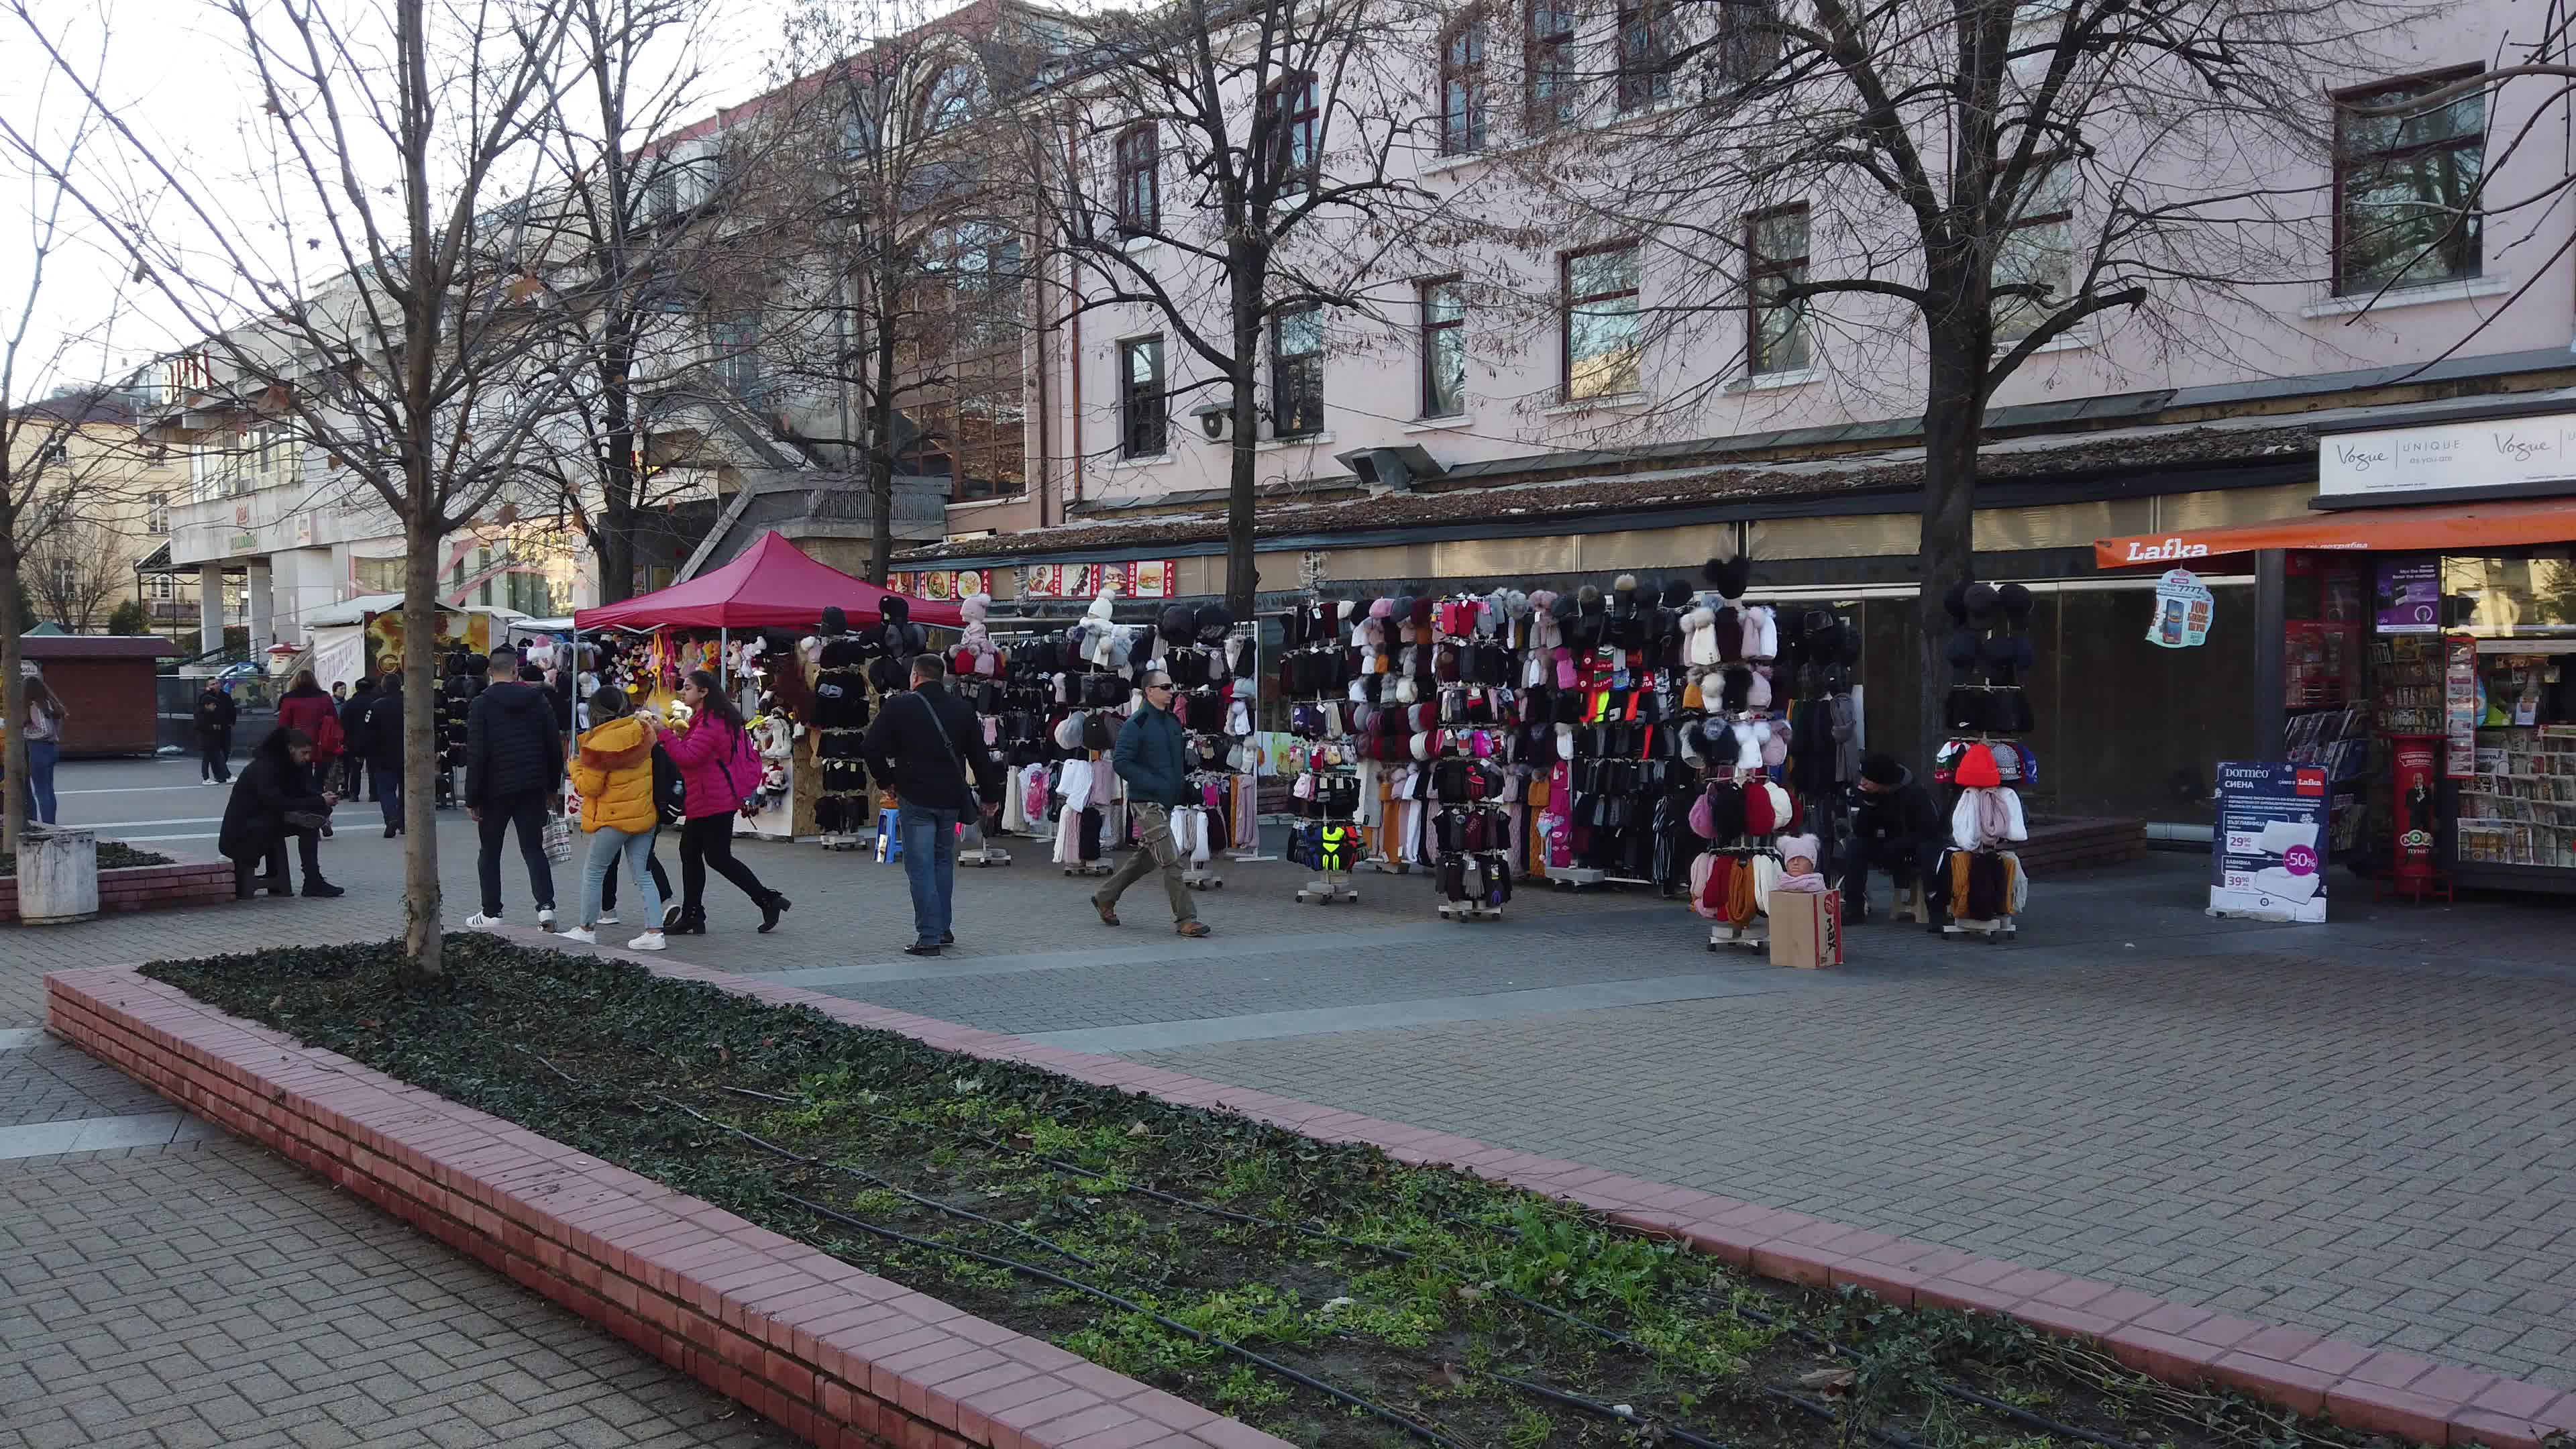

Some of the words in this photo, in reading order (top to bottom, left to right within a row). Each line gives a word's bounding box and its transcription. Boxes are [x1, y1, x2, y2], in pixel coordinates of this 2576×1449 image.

[2403, 439, 2461, 451] UNIQUE
[2495, 433, 2551, 461] Vogue
[2337, 445, 2388, 471] Vogue
[2127, 538, 2208, 561] Lafka
[2224, 780, 2254, 789] СИЕНА
[2298, 778, 2322, 786] Lafka
[2285, 852, 2315, 867] -50%
